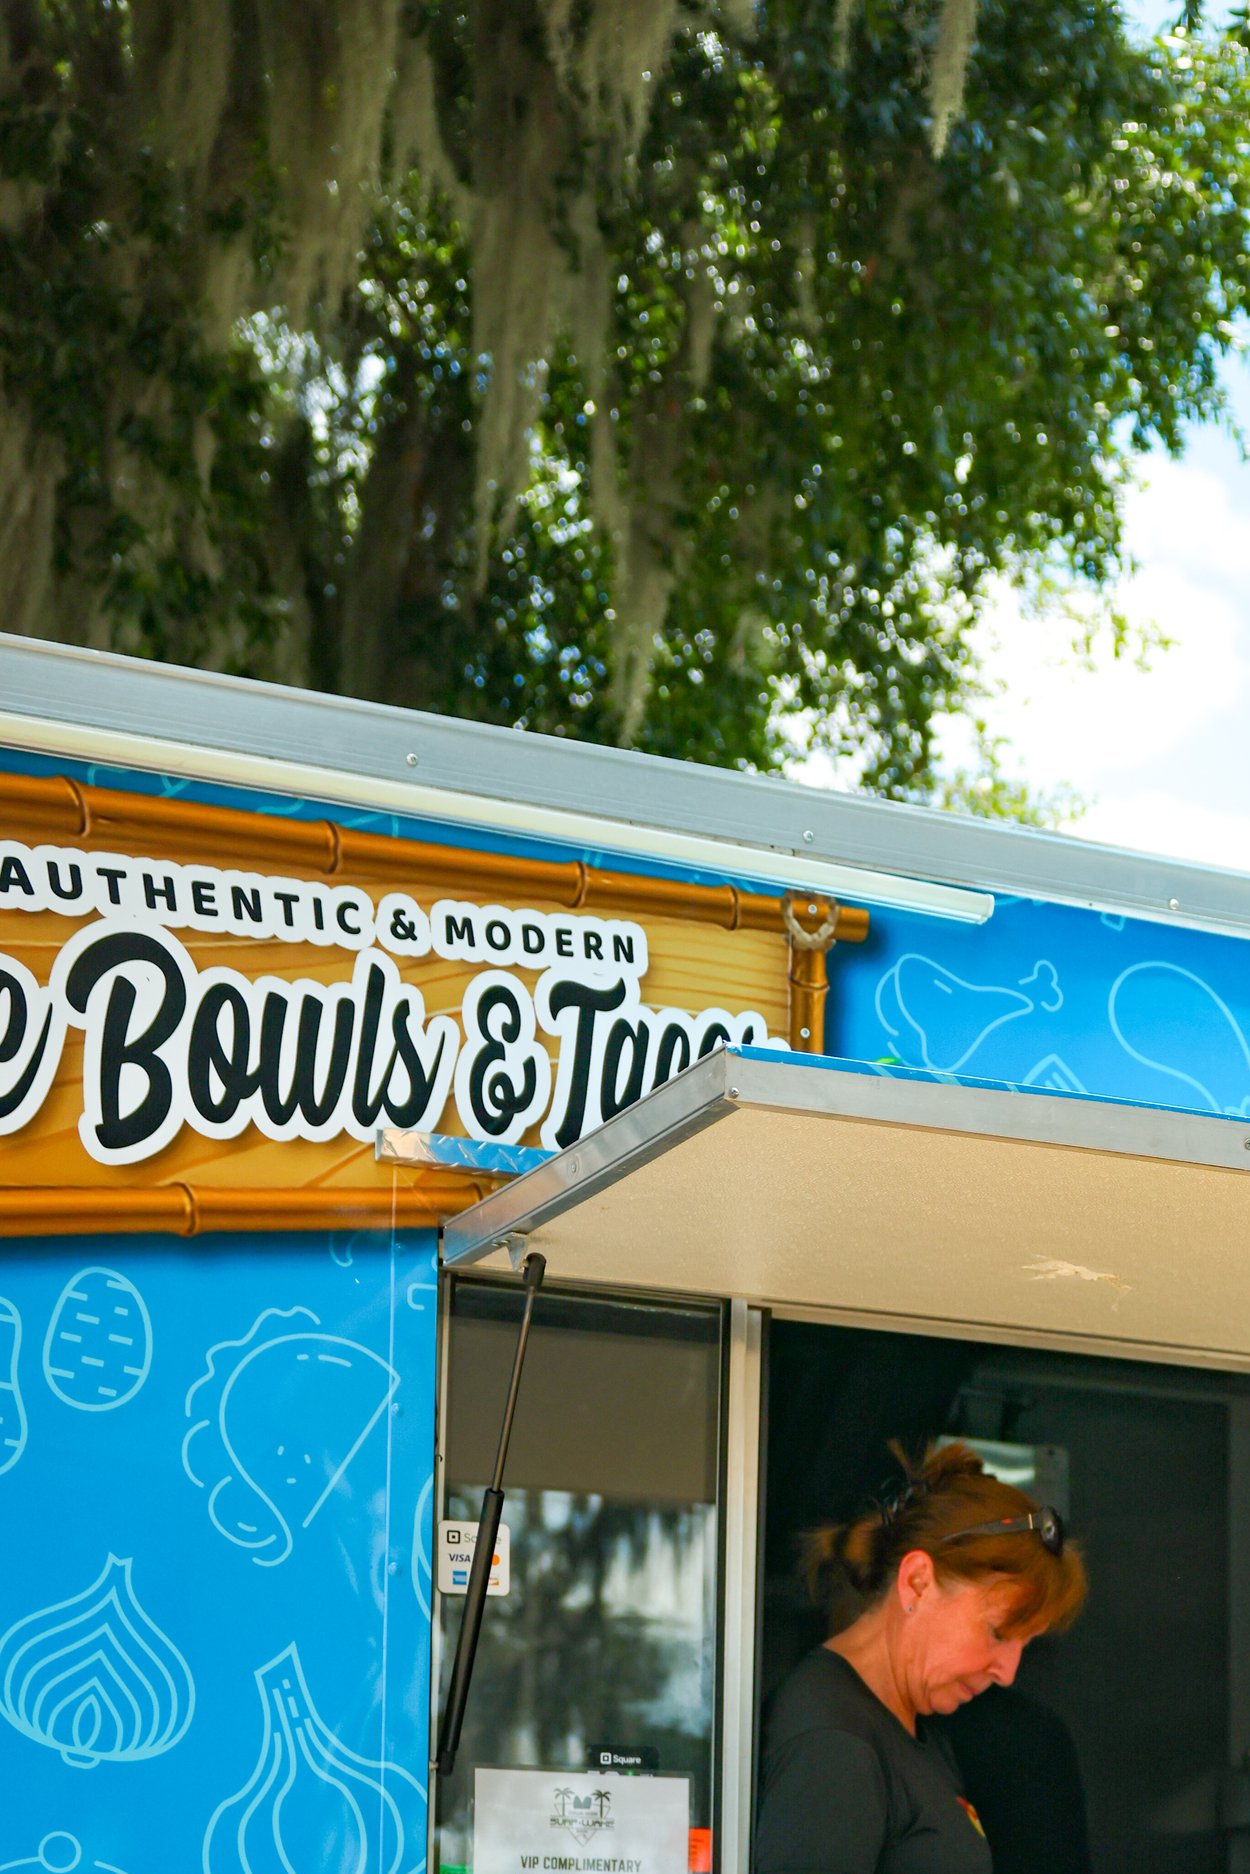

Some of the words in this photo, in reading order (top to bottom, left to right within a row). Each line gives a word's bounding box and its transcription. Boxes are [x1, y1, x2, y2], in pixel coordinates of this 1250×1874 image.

[0, 853, 362, 936] AUTHENTIC
[390, 909, 417, 942] &
[445, 916, 636, 964] MODERN
[65, 931, 445, 1149] Bowls
[469, 984, 536, 1138] &
[550, 977, 753, 1149] Tac
[448, 1553, 471, 1562] VISA
[613, 1754, 641, 1766] Square
[520, 1855, 539, 1869] VIP
[543, 1857, 641, 1873] COMPLIMENTARY
